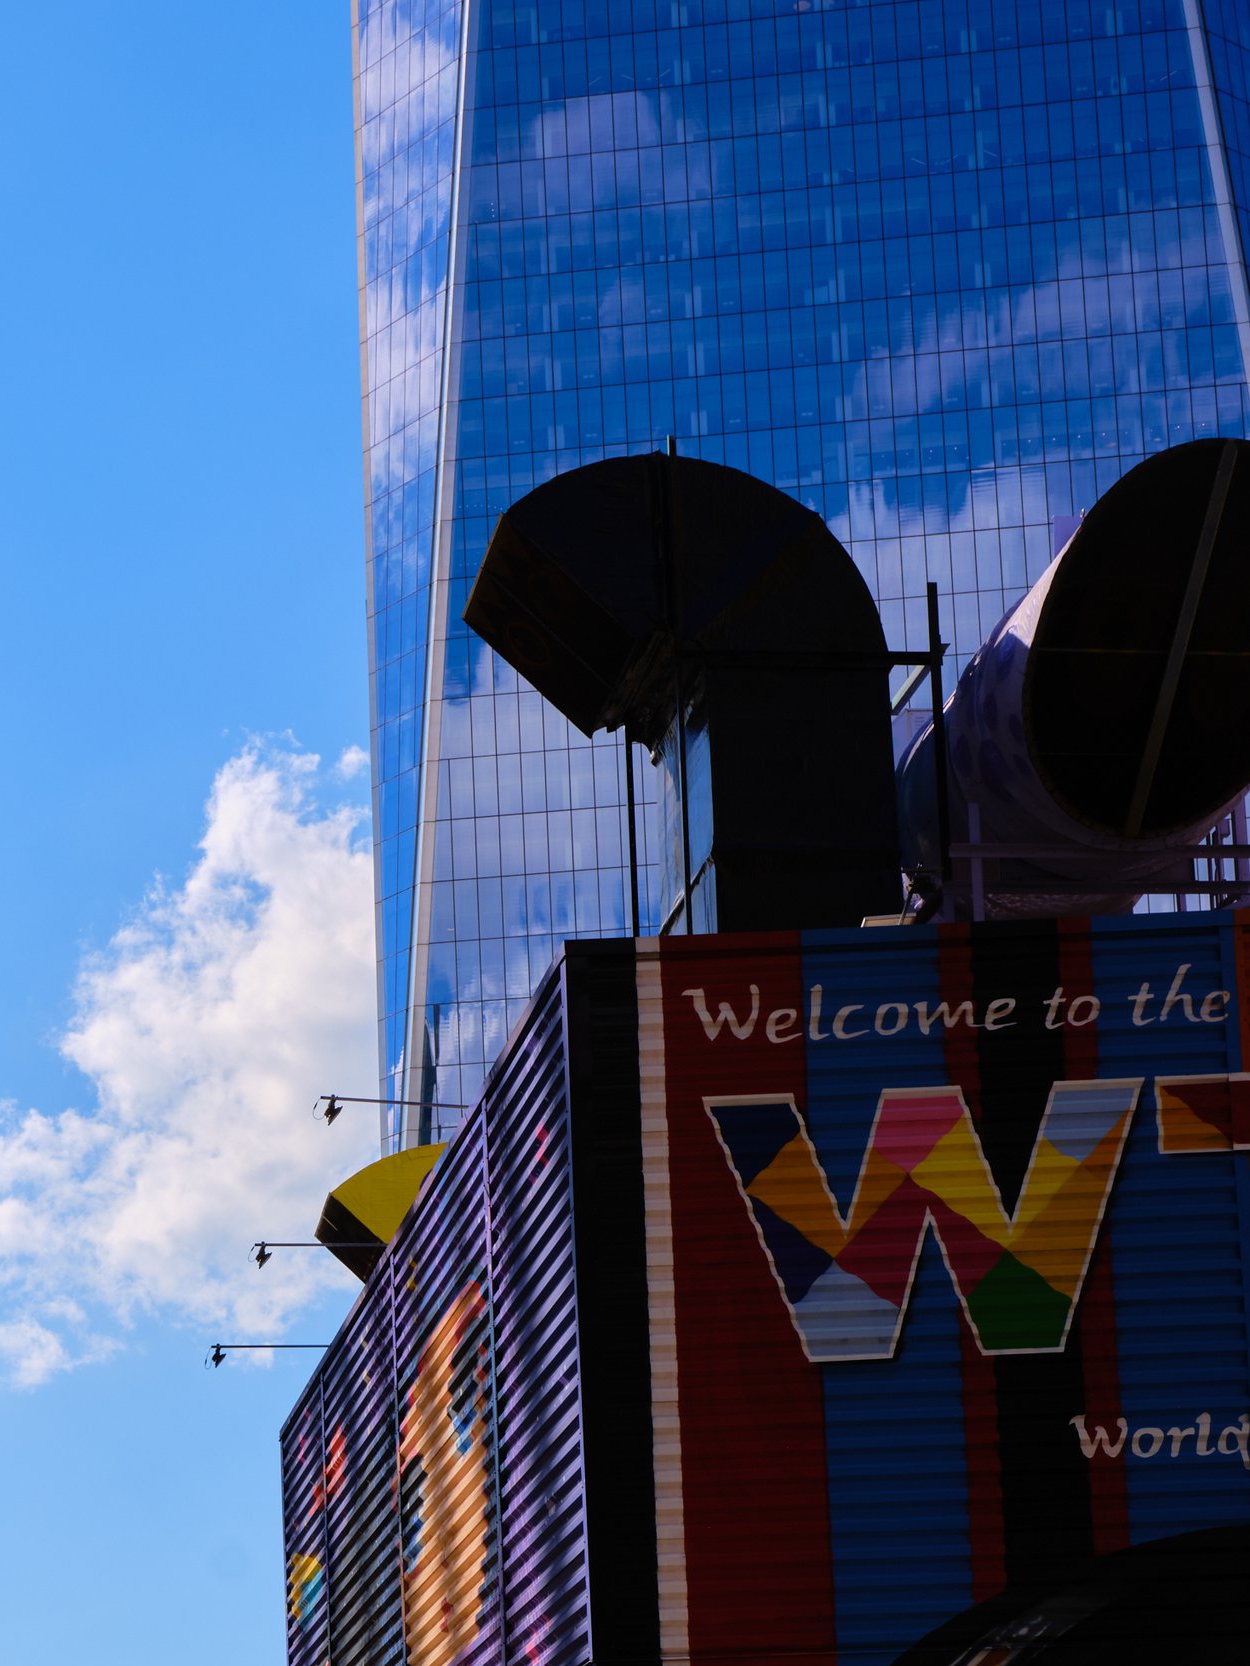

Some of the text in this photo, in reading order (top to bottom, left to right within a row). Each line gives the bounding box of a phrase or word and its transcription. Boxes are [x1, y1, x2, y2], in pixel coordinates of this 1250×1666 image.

[681, 963, 1231, 1045] Welcome to the
[1068, 1411, 1250, 1470] World
